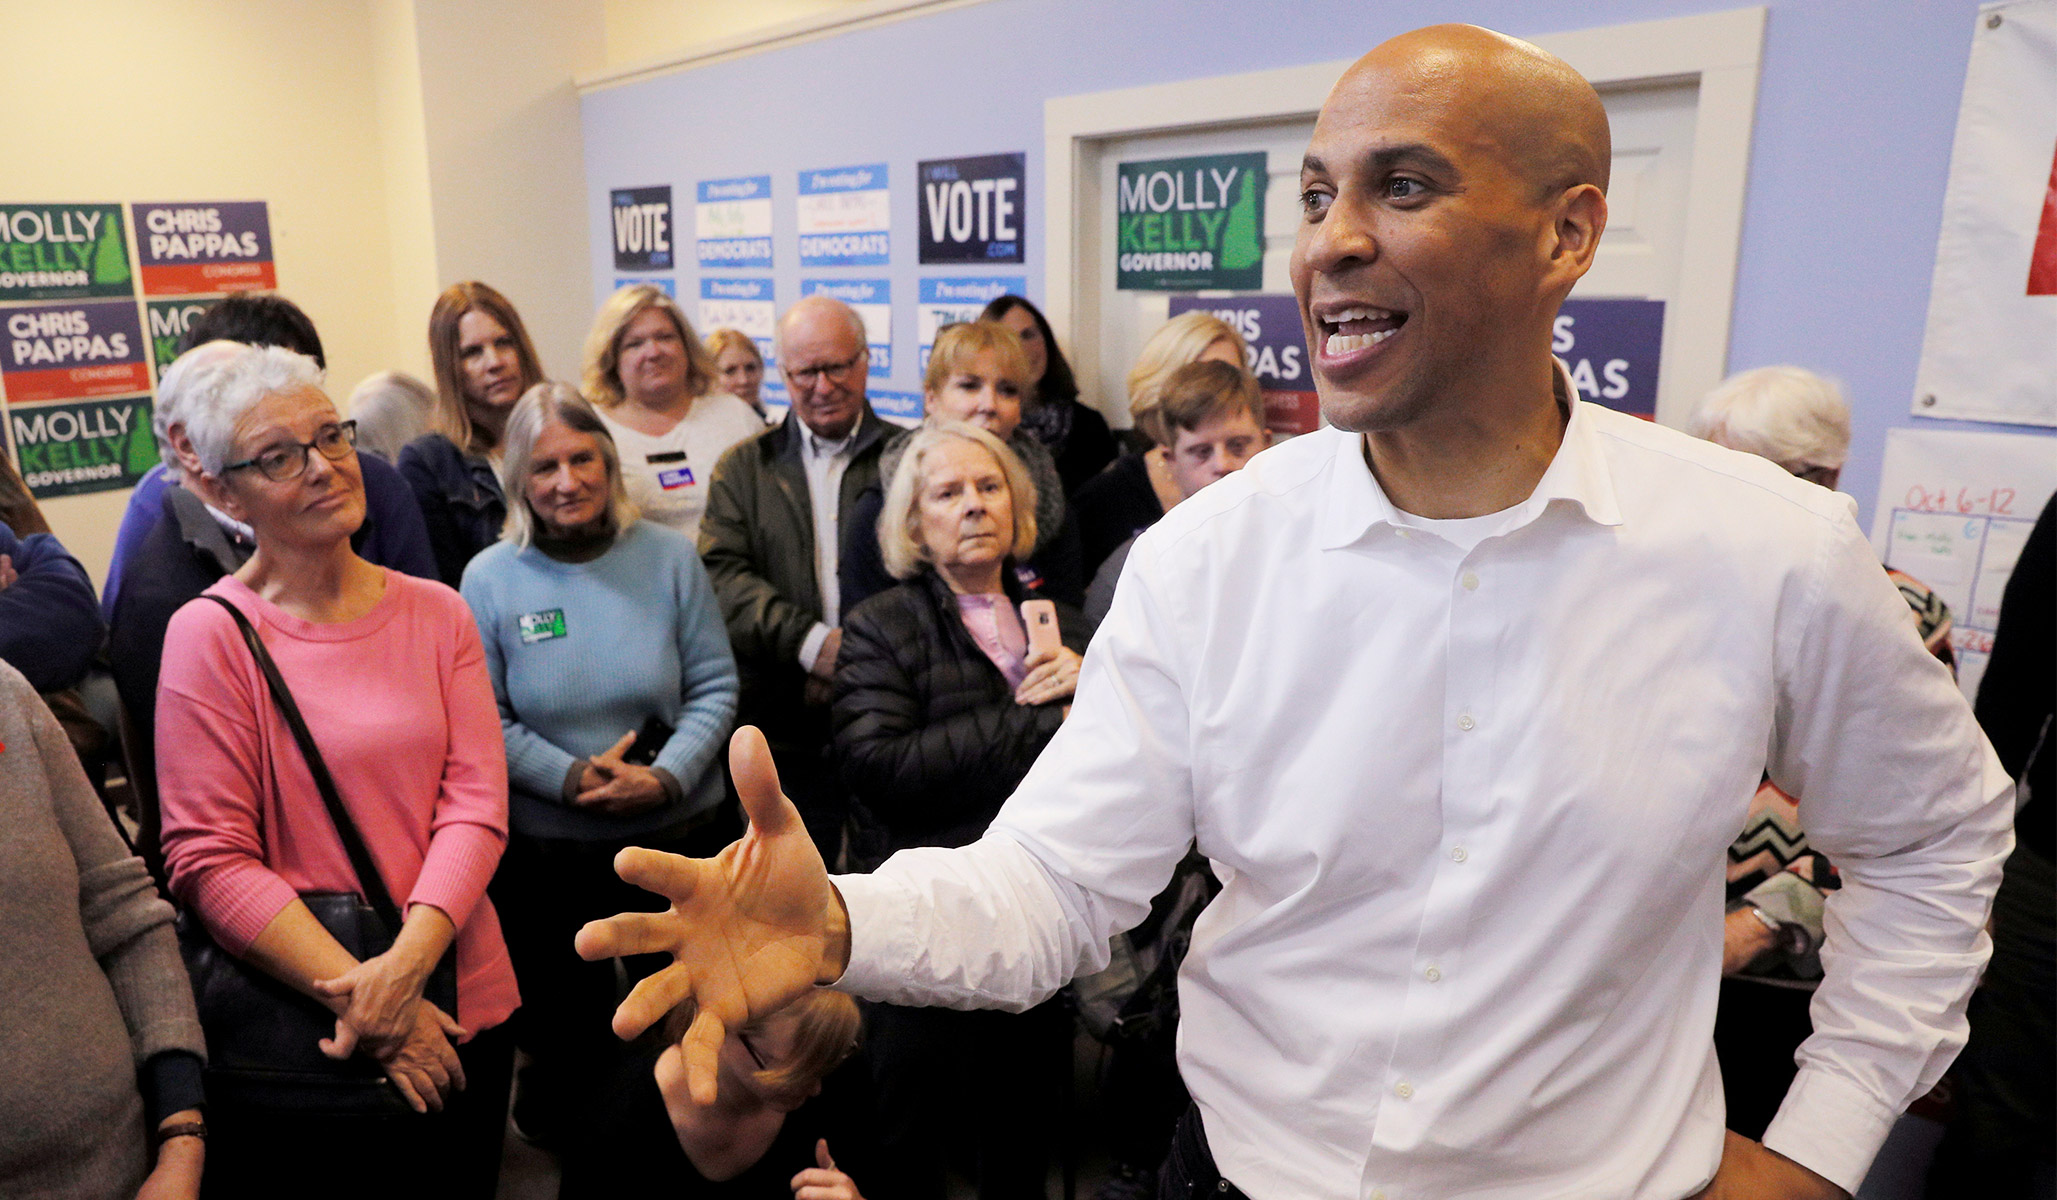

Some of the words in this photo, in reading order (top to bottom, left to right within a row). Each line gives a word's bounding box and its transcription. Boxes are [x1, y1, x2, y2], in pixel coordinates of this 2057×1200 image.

[1119, 166, 1239, 213] MOLLY
[145, 208, 223, 234] CHRIS
[925, 177, 1018, 243] VOTE
[613, 203, 670, 253] VOTE
[1120, 211, 1227, 250] KELLY
[150, 231, 259, 259] PAPPAS
[800, 235, 889, 259] DEMOCRATS
[1119, 250, 1214, 272] GOVERNOR
[0, 269, 90, 289] OVERNOR
[8, 310, 89, 338] CHRIS
[12, 332, 130, 366] PAPPAS
[13, 405, 133, 445] MOLLY
[20, 438, 130, 470] KELLY
[24, 462, 122, 489] GOVERNOR
[1904, 484, 1948, 513] Oct
